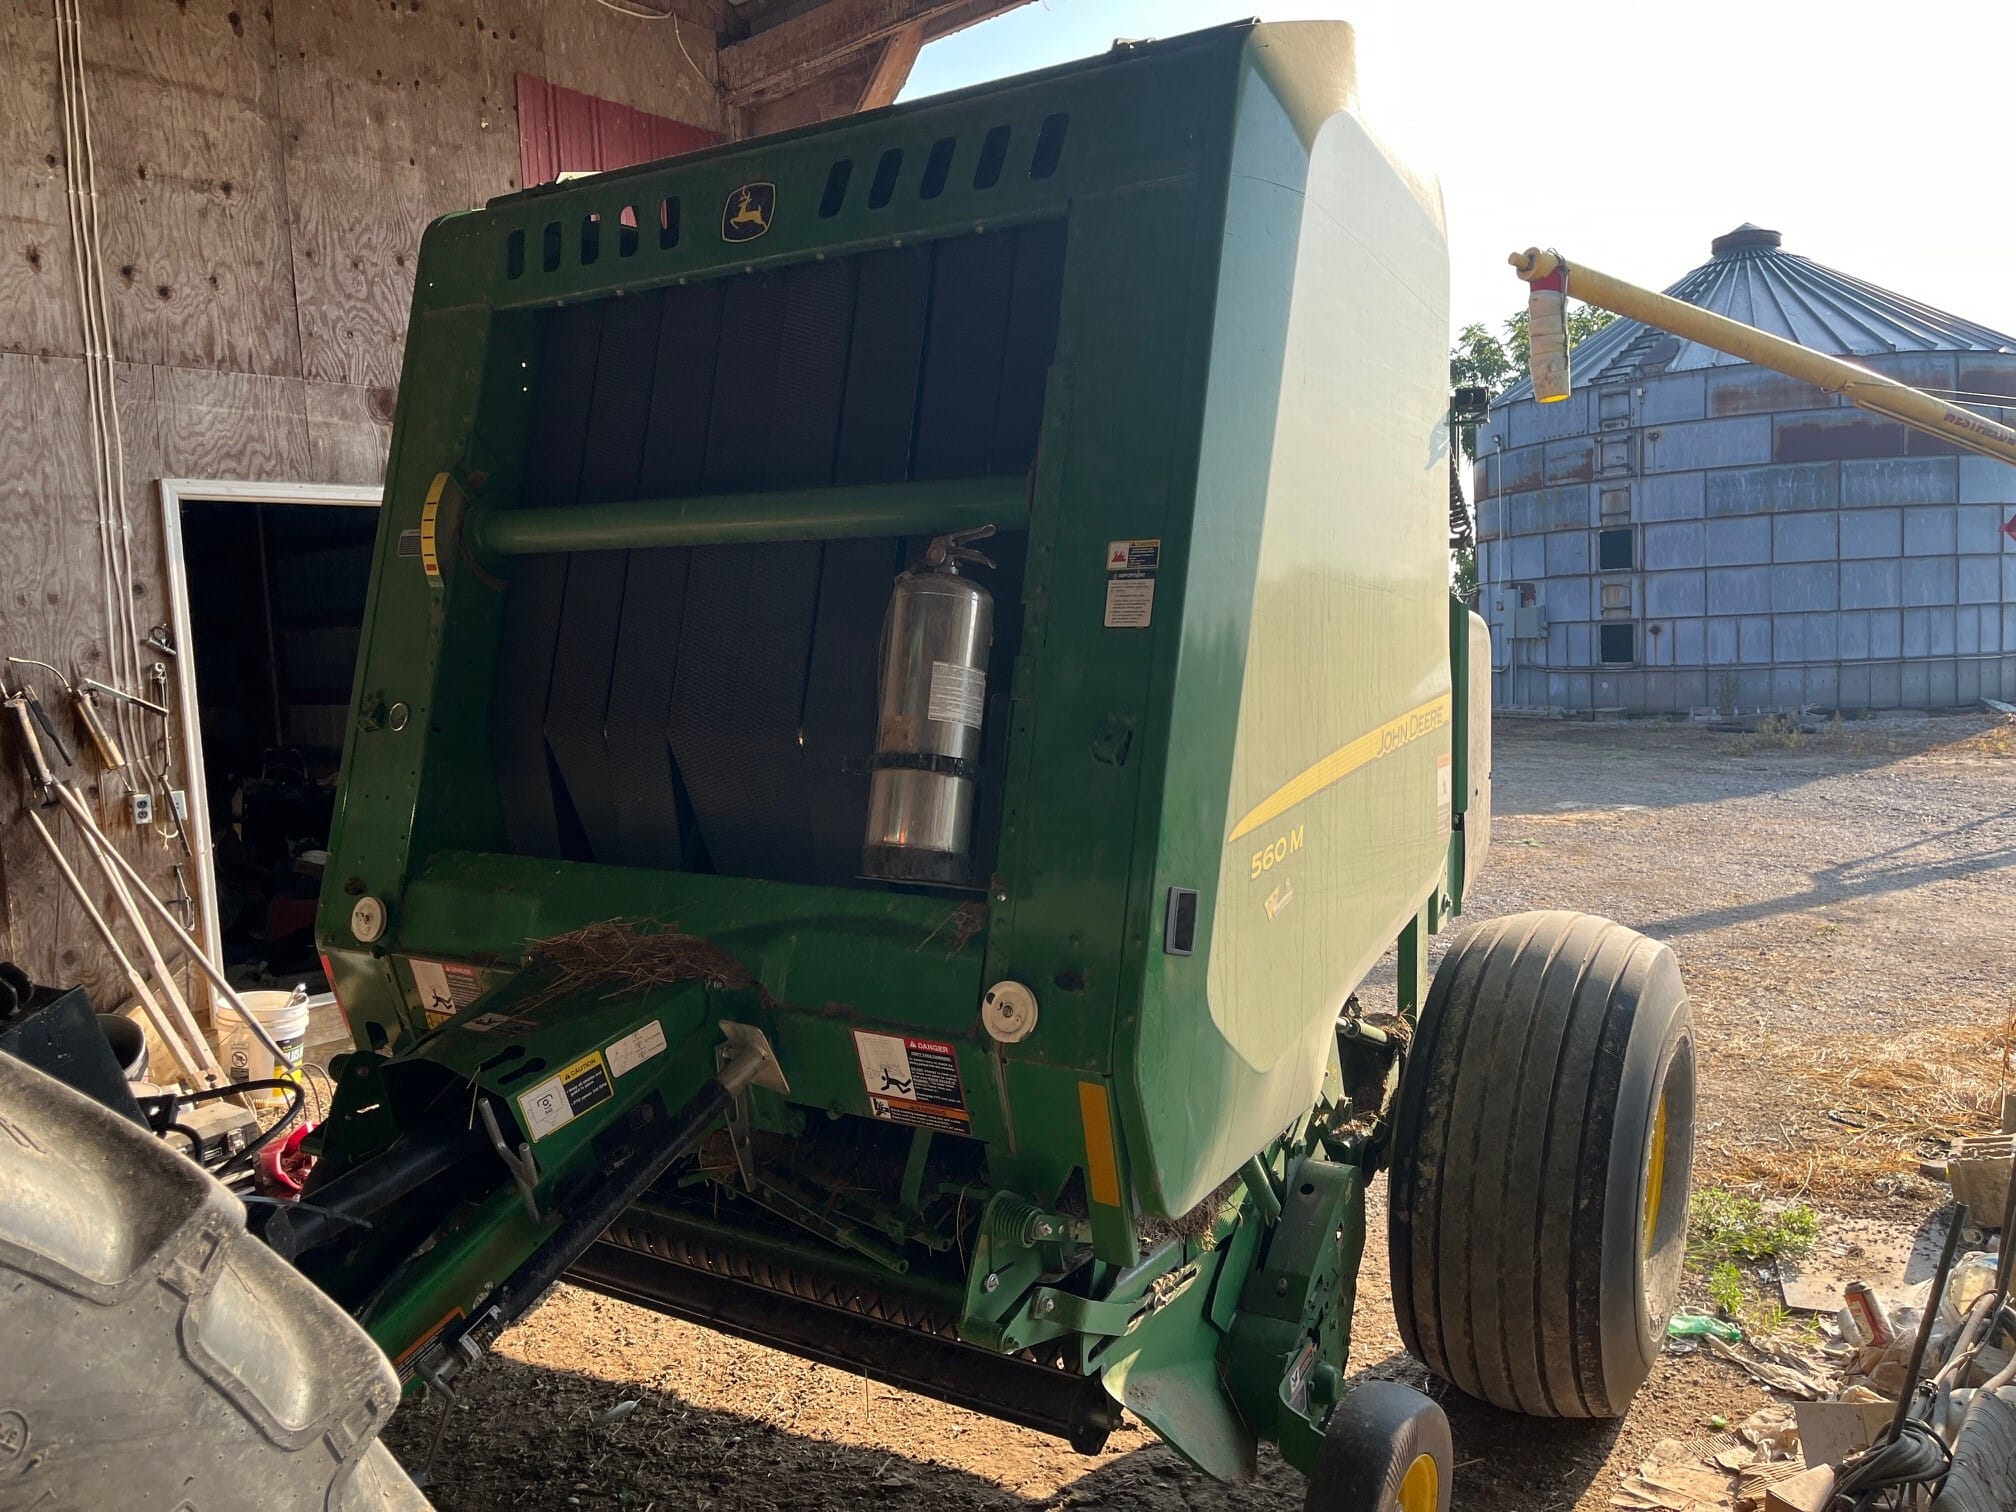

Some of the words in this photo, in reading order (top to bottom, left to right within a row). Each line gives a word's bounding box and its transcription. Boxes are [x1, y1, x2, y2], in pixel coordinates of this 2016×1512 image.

[1376, 721, 1408, 759] JOHN
[1409, 706, 1444, 742] DEERE
[1250, 834, 1288, 881] 560
[1290, 823, 1304, 855] M
[918, 1042, 949, 1054] DANGER
[570, 1058, 597, 1076] CAUTION
